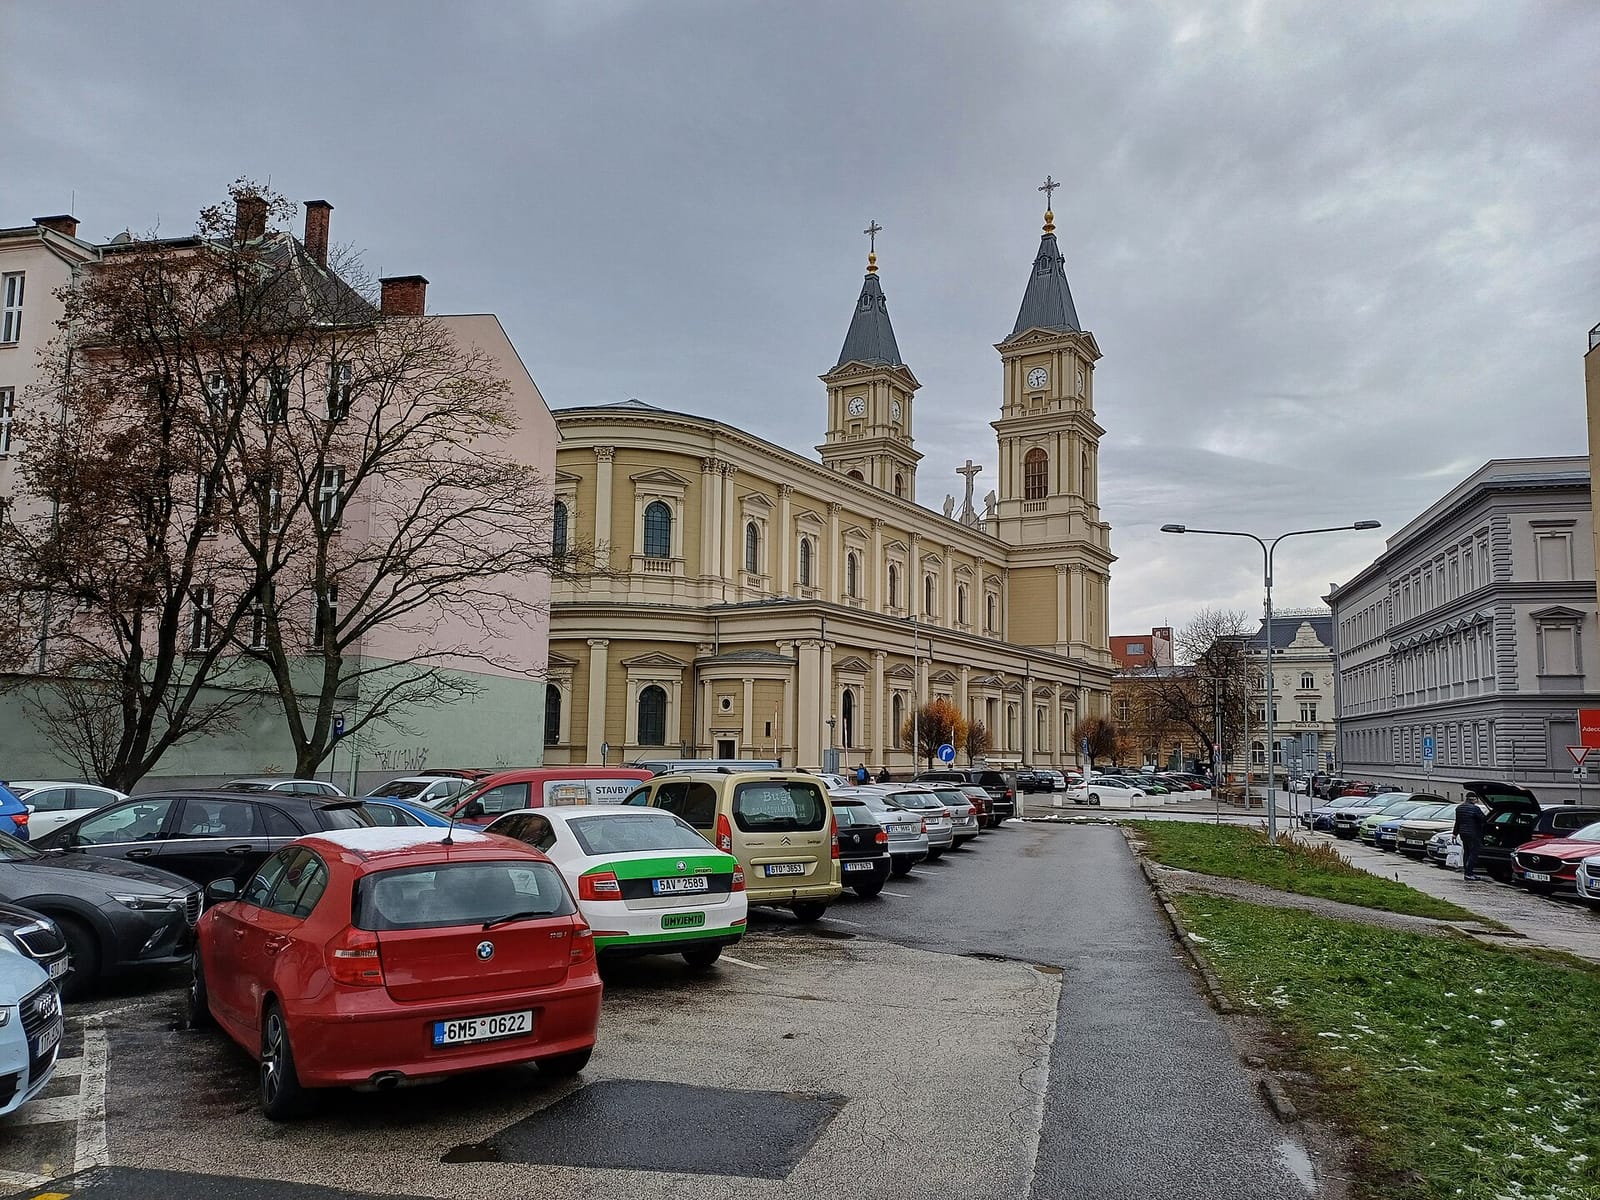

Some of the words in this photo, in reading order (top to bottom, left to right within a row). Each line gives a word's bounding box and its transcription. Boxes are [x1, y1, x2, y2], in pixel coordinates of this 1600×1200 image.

[595, 786, 629, 794] STAVBY
[660, 879, 676, 890] 5AV
[682, 878, 704, 889] 2589
[447, 1021, 477, 1040] 6M5
[488, 1014, 525, 1034] 0622
